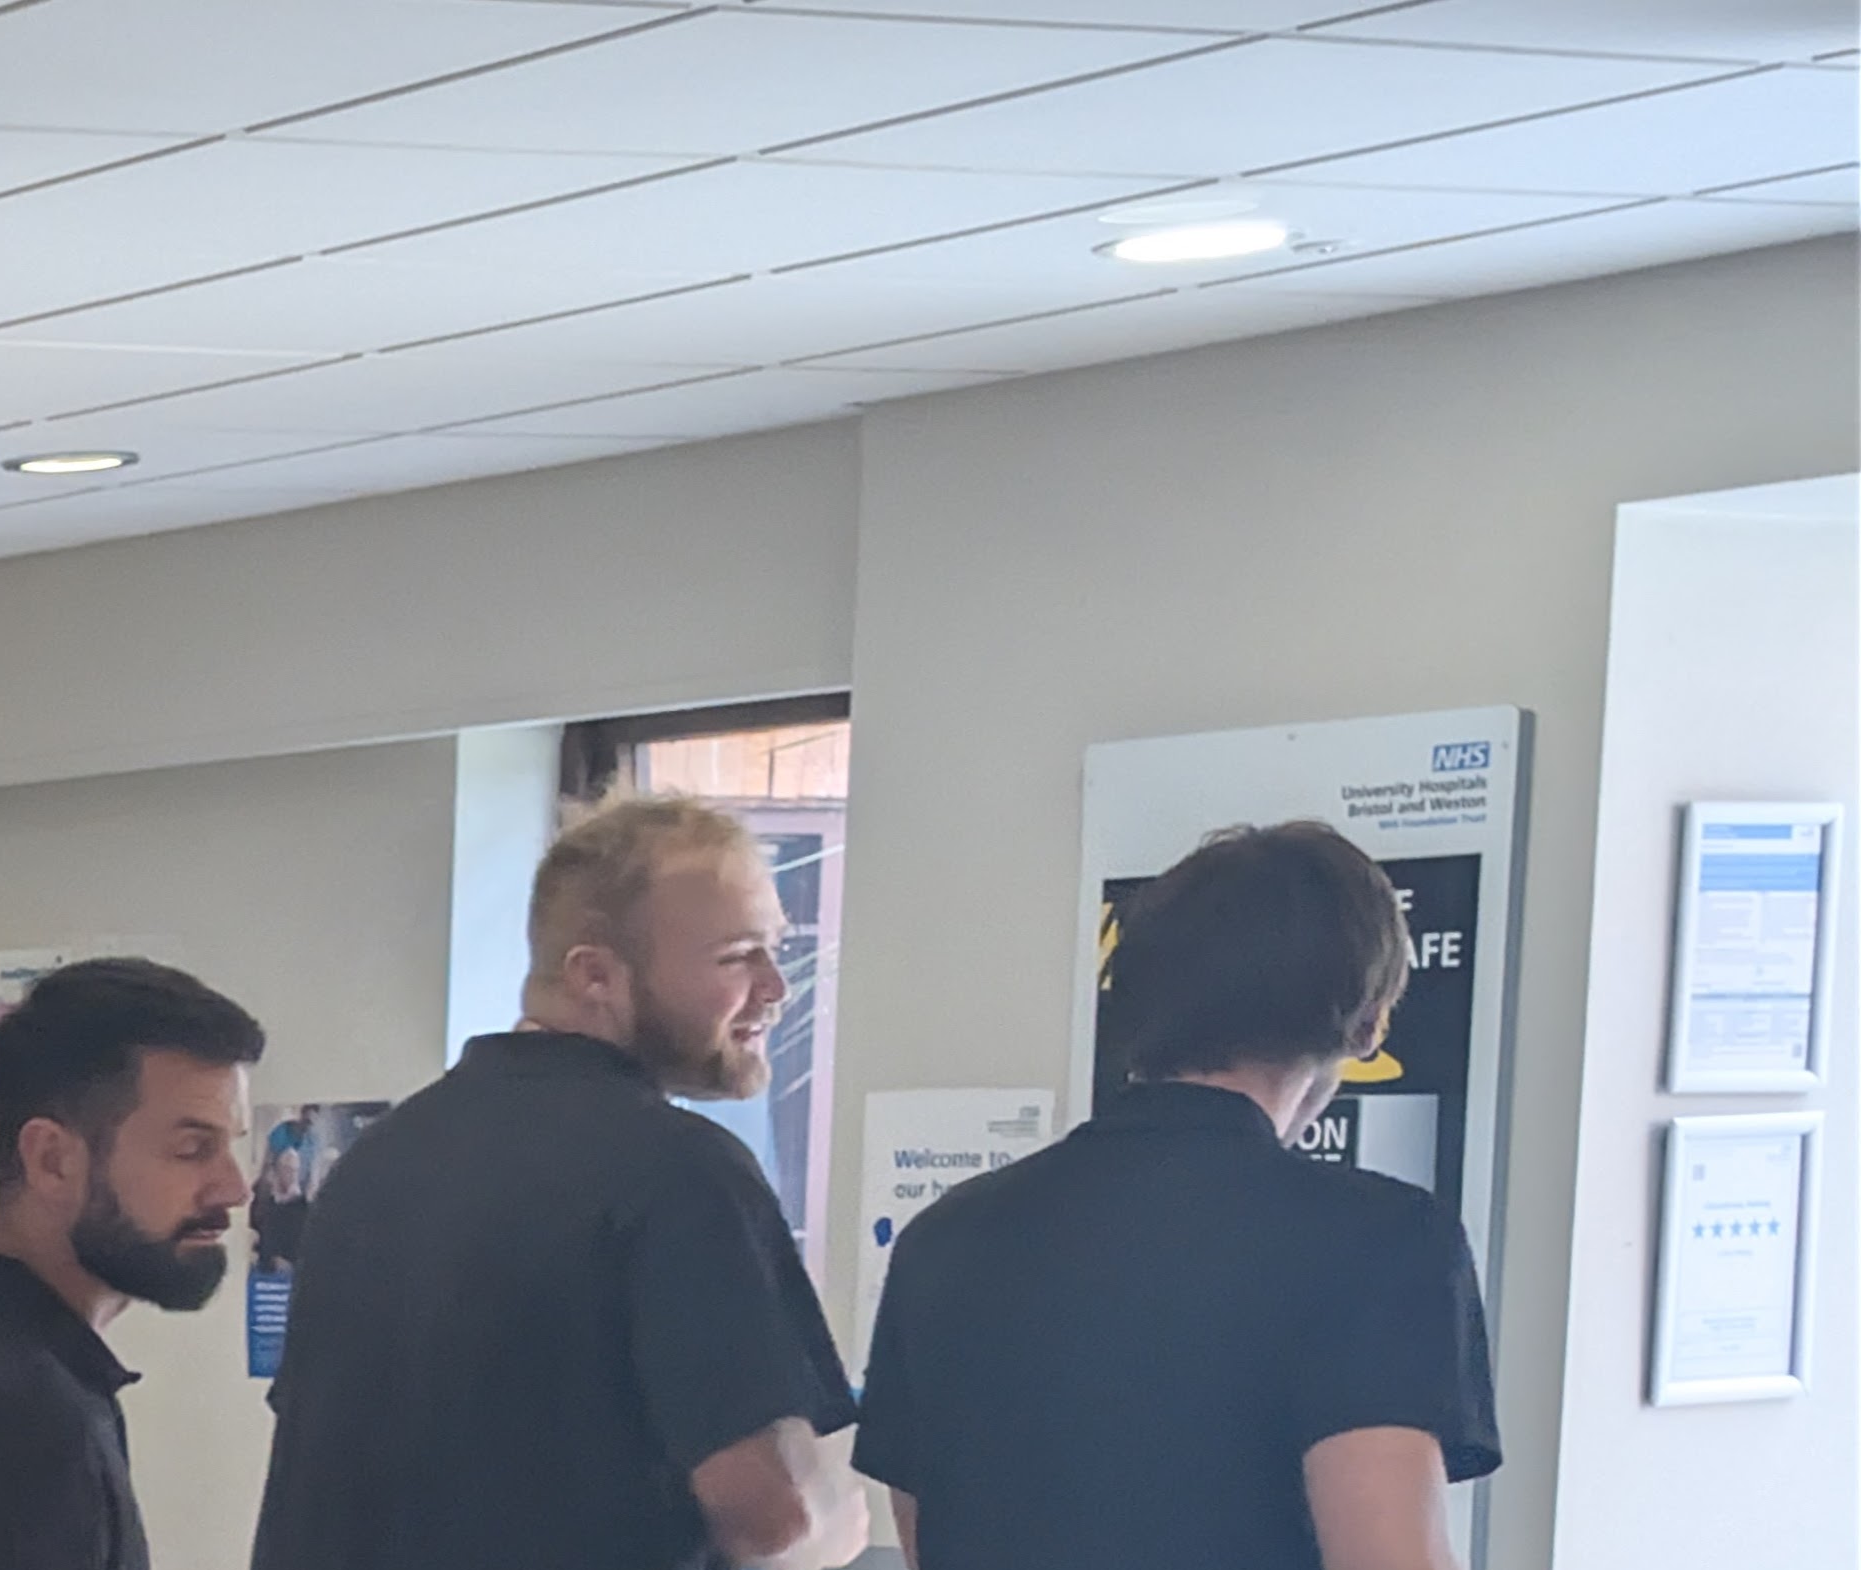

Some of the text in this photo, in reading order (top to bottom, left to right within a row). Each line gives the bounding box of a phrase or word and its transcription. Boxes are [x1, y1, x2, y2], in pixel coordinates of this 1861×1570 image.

[1435, 744, 1487, 770] NHS
[1342, 776, 1487, 800] University Hospitals
[1348, 796, 1487, 817] Bristol and Weston
[1407, 931, 1463, 968] AFE
[1296, 1117, 1348, 1150] ON
[895, 1147, 1011, 1169] Welcome to
[894, 1182, 926, 1199] our
